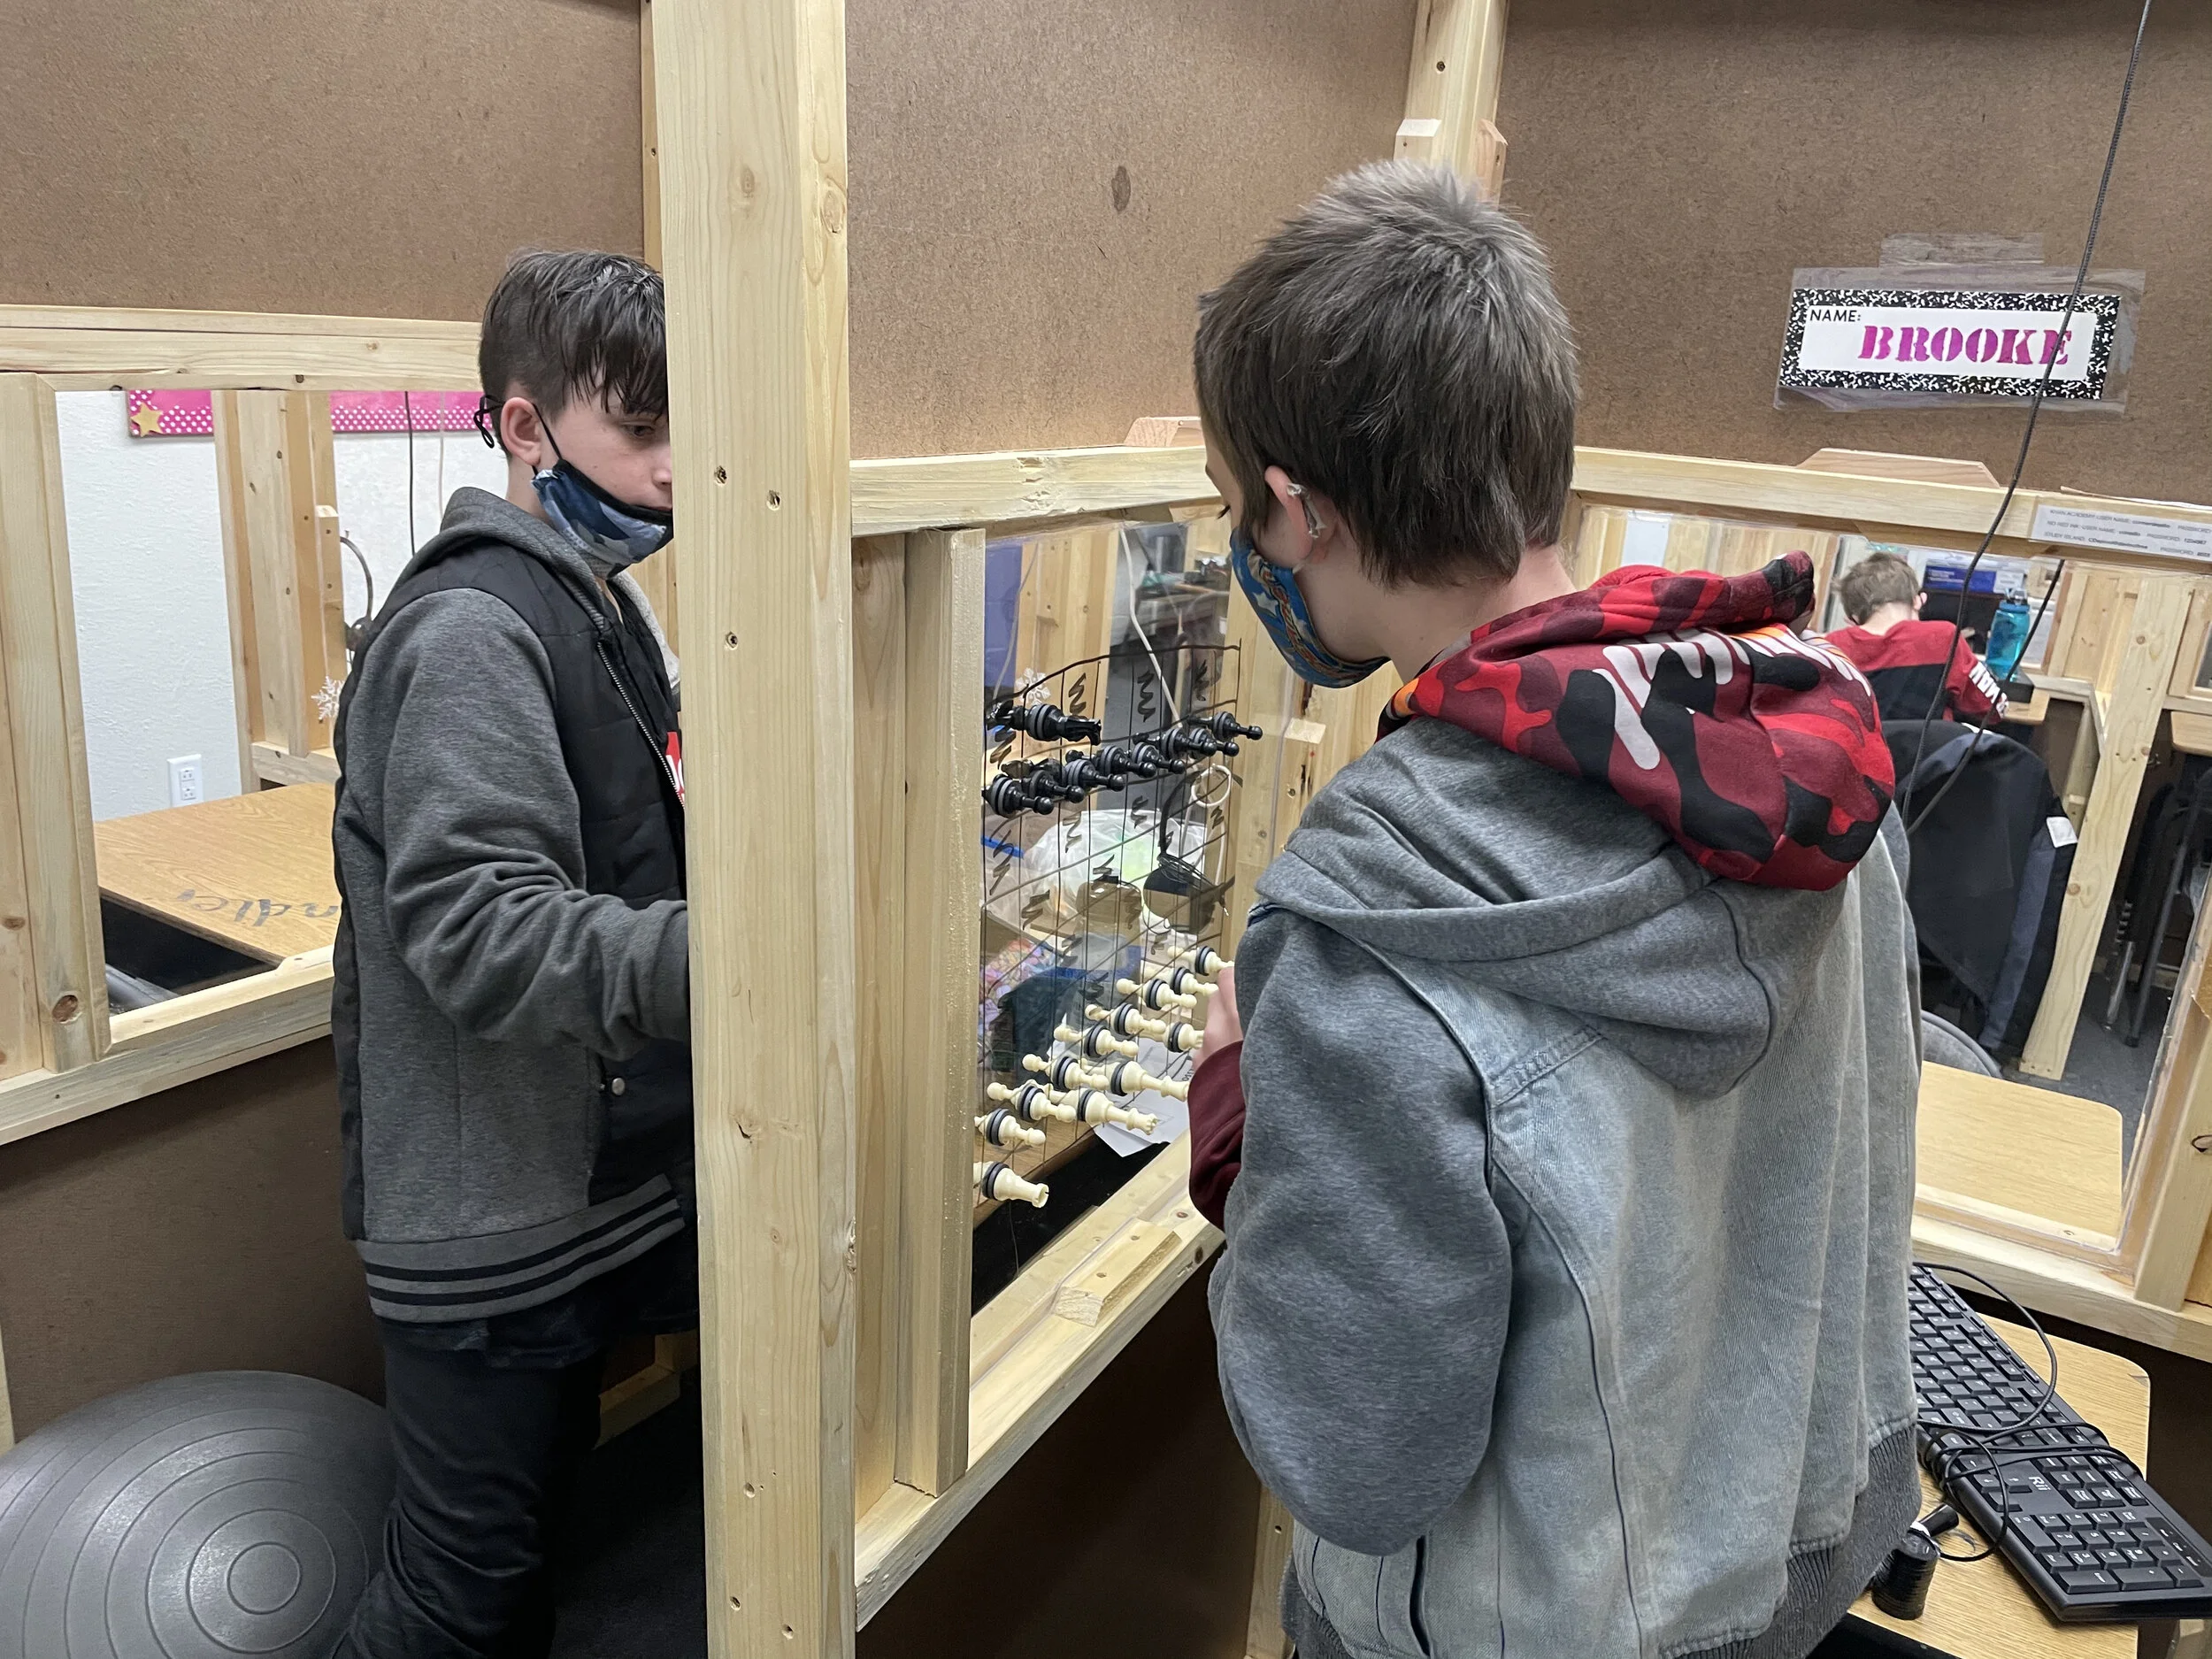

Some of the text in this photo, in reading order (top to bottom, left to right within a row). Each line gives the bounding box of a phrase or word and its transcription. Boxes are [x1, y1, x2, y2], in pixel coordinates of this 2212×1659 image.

[1809, 309, 1862, 323] NAME:
[1858, 326, 2072, 365] BROOKE
[2029, 1476, 2051, 1491] Rii
